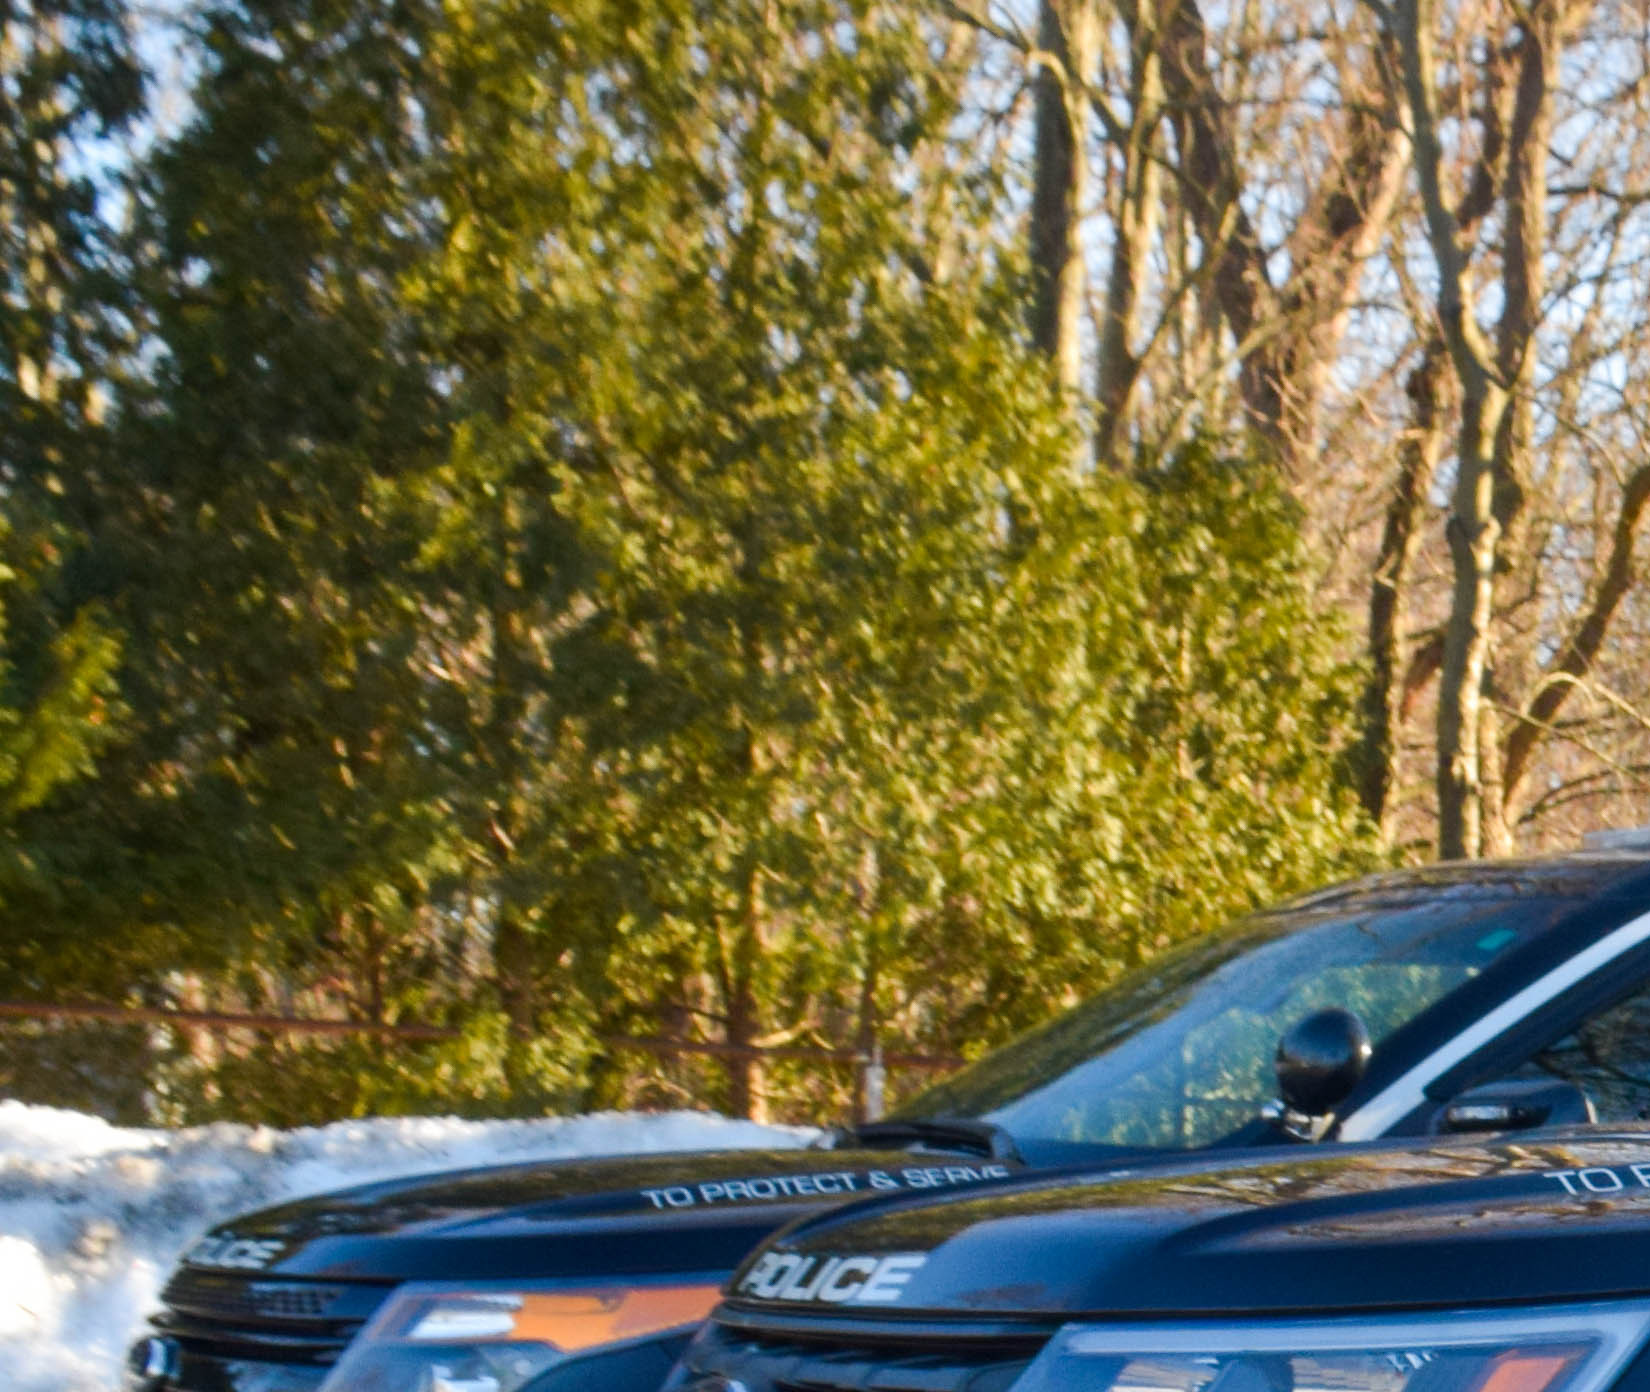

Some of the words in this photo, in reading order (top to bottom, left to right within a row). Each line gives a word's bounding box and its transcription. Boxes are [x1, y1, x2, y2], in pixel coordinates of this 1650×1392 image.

[641, 1187, 694, 1209] TO
[699, 1172, 860, 1203] PROTECT
[869, 1170, 899, 1189] &
[1545, 1167, 1624, 1196] TO
[739, 1251, 927, 1302] POLICE
